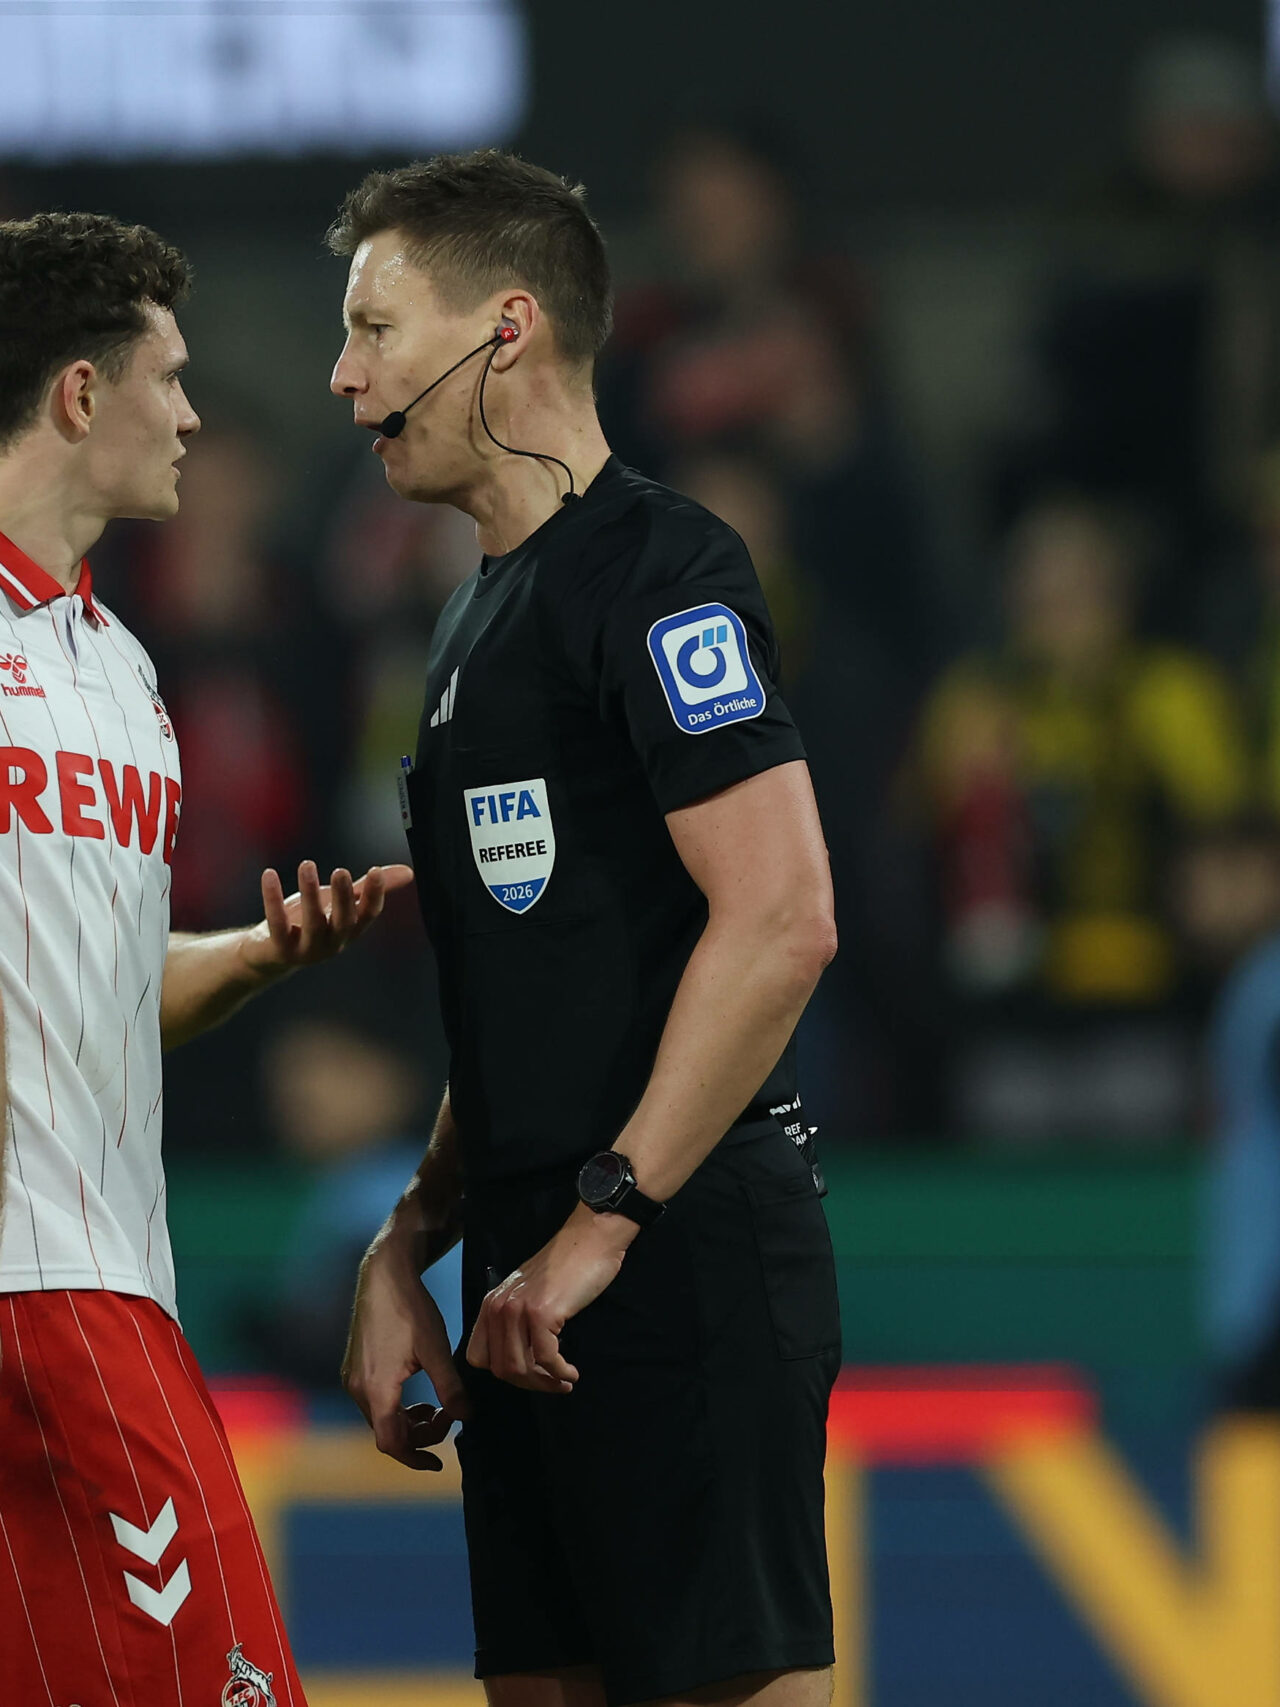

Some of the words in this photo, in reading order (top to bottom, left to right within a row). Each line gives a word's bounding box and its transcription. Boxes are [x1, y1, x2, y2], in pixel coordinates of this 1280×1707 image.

[0, 683, 47, 698] hummel
[687, 710, 713, 726] Das
[713, 697, 757, 717] Örtliche
[470, 789, 542, 827] FIFA
[478, 839, 548, 864] REFEREE
[502, 884, 534, 902] 2026
